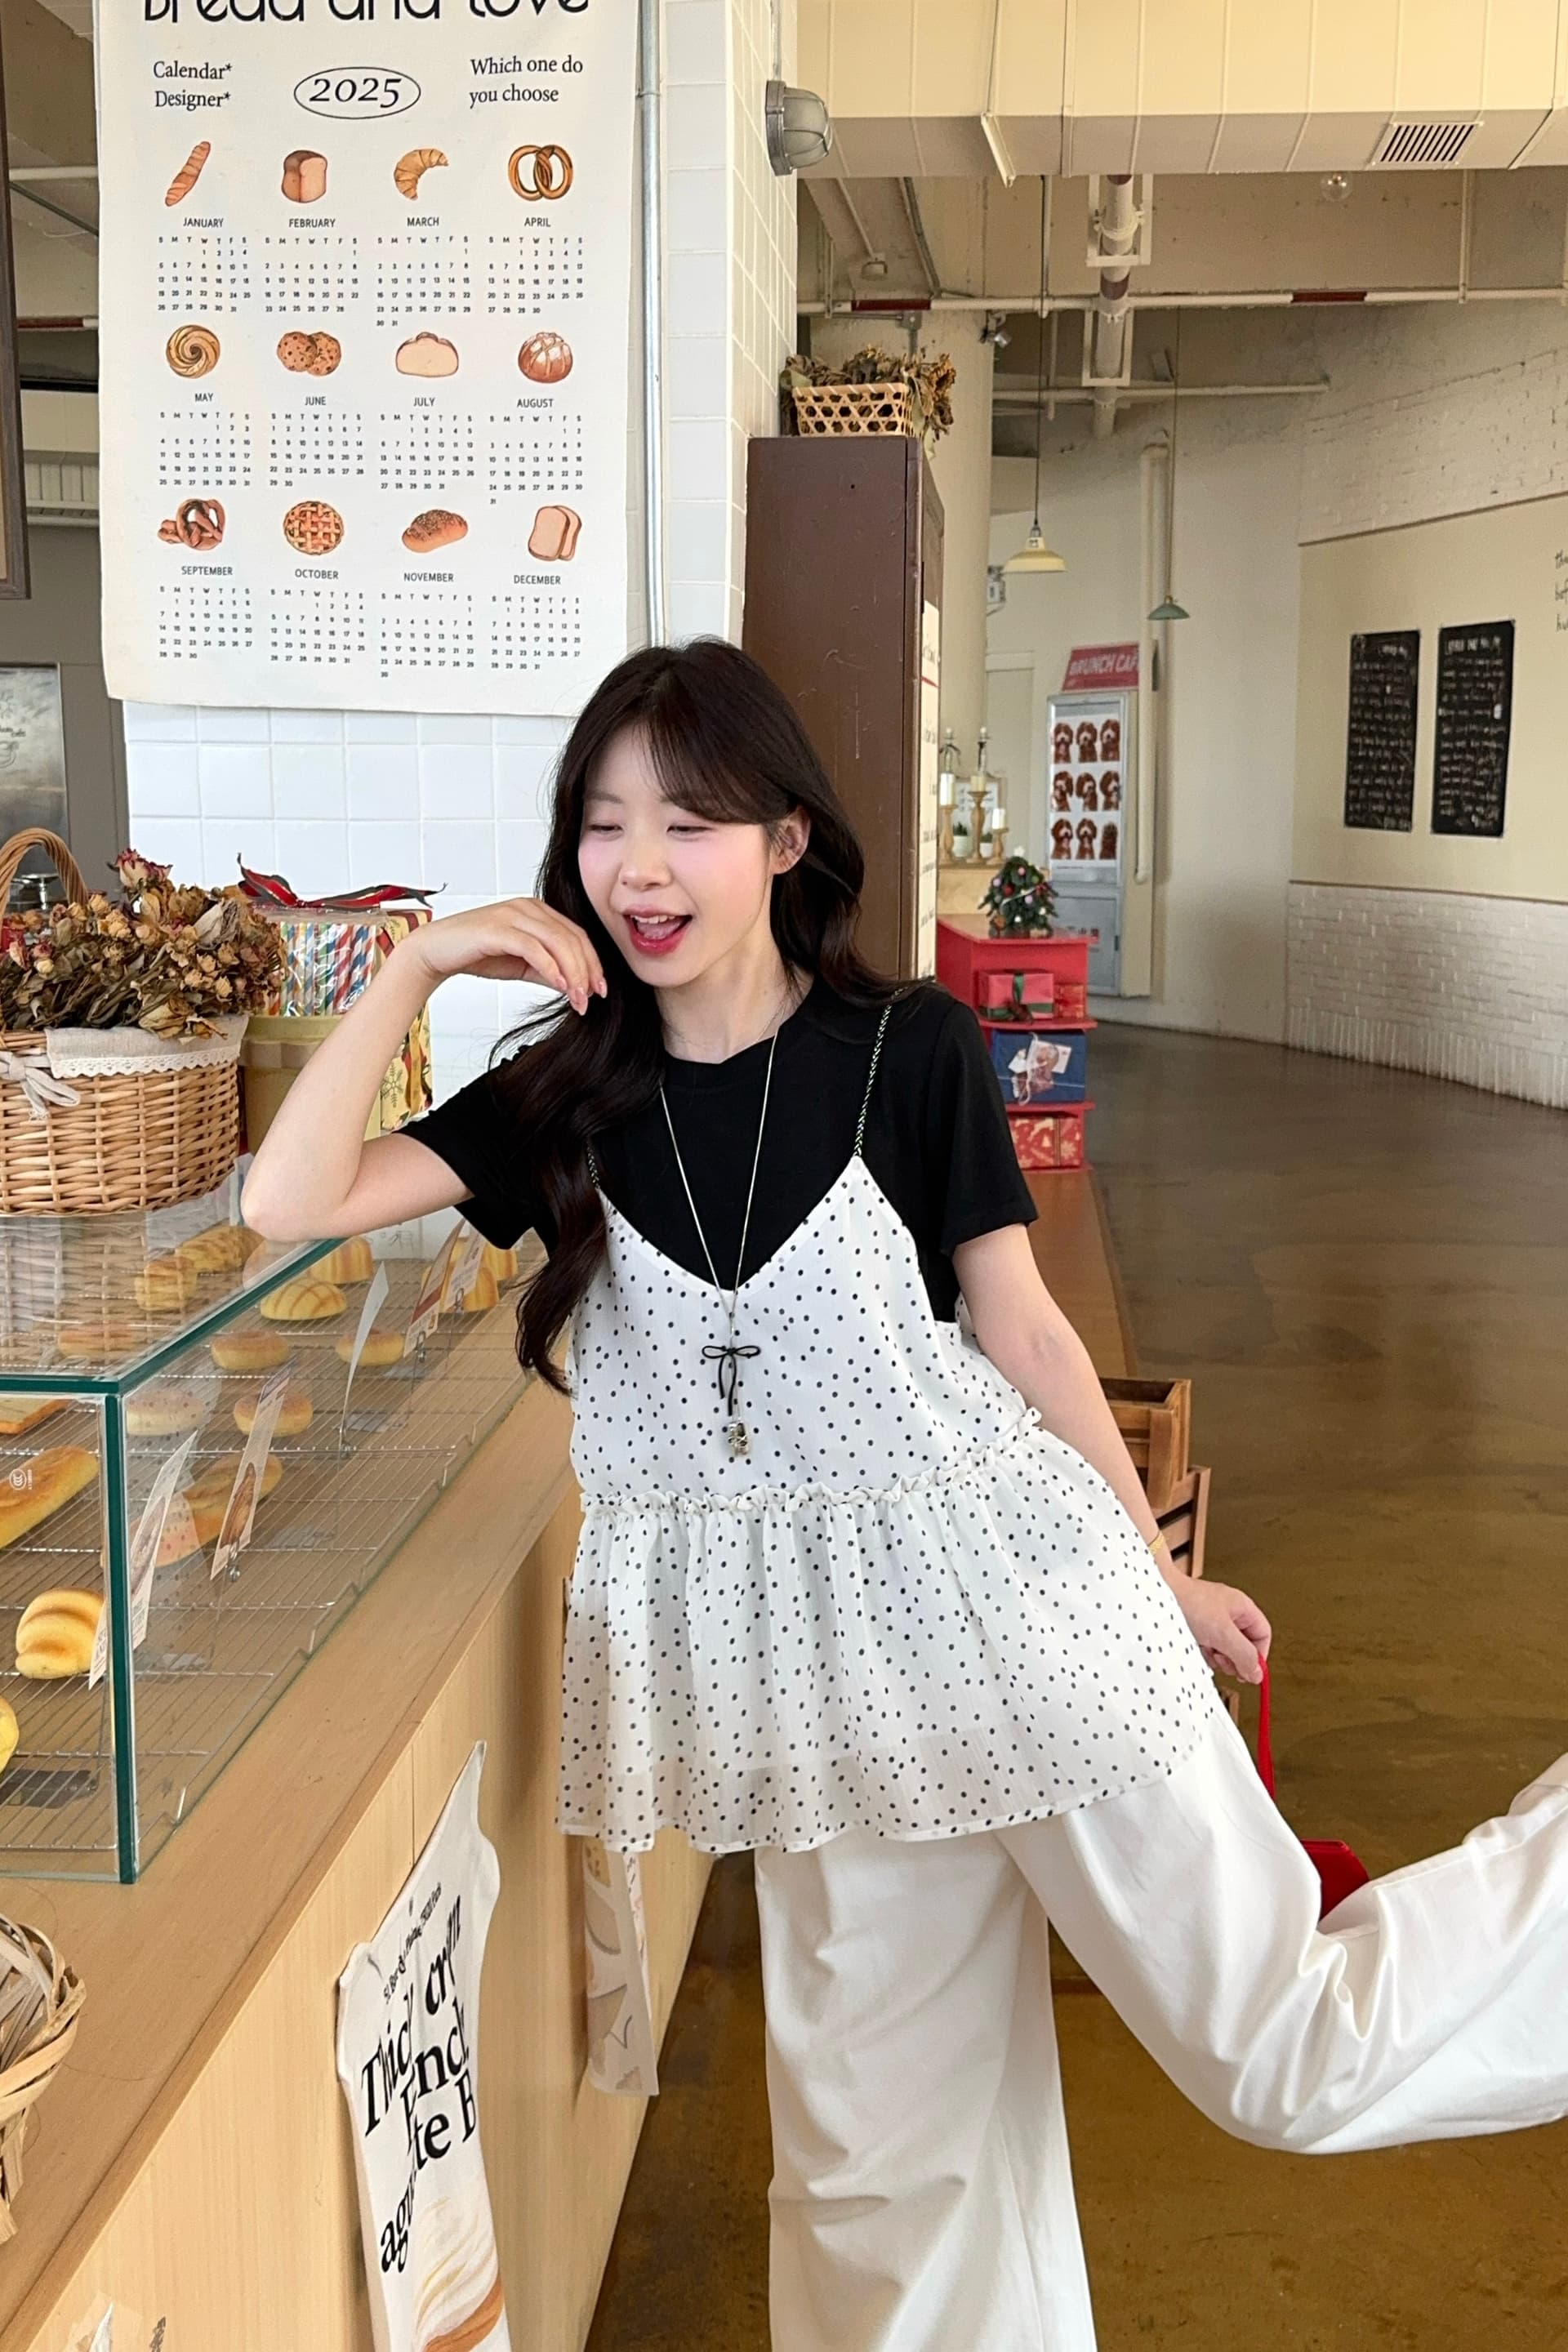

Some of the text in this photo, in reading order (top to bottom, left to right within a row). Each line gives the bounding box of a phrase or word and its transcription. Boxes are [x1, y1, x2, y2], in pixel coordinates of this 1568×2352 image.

[470, 54, 583, 75] Which one do
[309, 77, 402, 108] 2025
[469, 82, 559, 109] you choose
[183, 217, 224, 228] JANUARY
[289, 218, 336, 228] FEBRUARY
[408, 216, 439, 226] MARCH
[524, 217, 551, 227] APRIL
[195, 393, 213, 402] MAY
[305, 396, 326, 405] JUNE
[413, 398, 435, 407] JULY
[517, 399, 553, 408] AUGUST
[181, 566, 233, 576] SEPTEMBER
[295, 568, 338, 579] OCTOBER
[404, 572, 453, 582] NOVEMBER
[514, 575, 560, 585] DECEMBER
